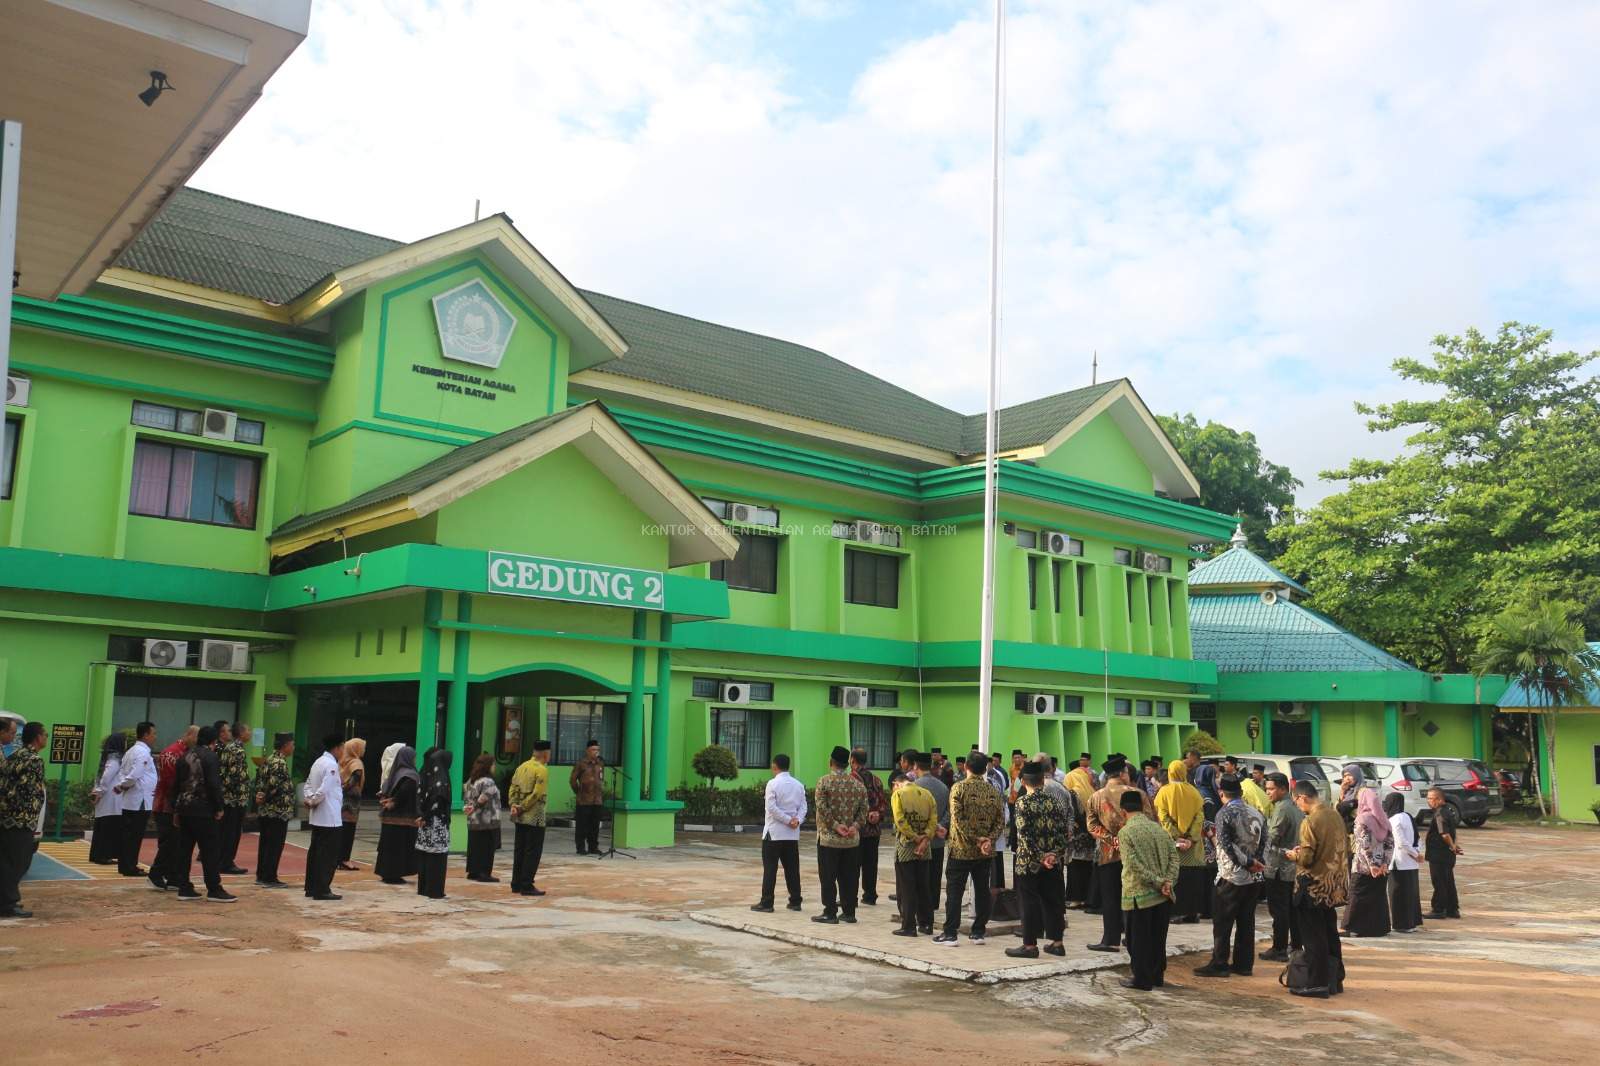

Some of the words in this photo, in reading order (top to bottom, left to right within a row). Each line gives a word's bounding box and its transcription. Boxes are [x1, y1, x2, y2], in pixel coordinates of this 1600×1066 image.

[412, 364, 482, 385] KEMENTERIAN
[483, 379, 516, 393] AGAMA
[437, 381, 462, 394] KOTA
[464, 387, 496, 401] BATAM
[490, 558, 634, 601] GEDUNG
[643, 576, 663, 604] 2
